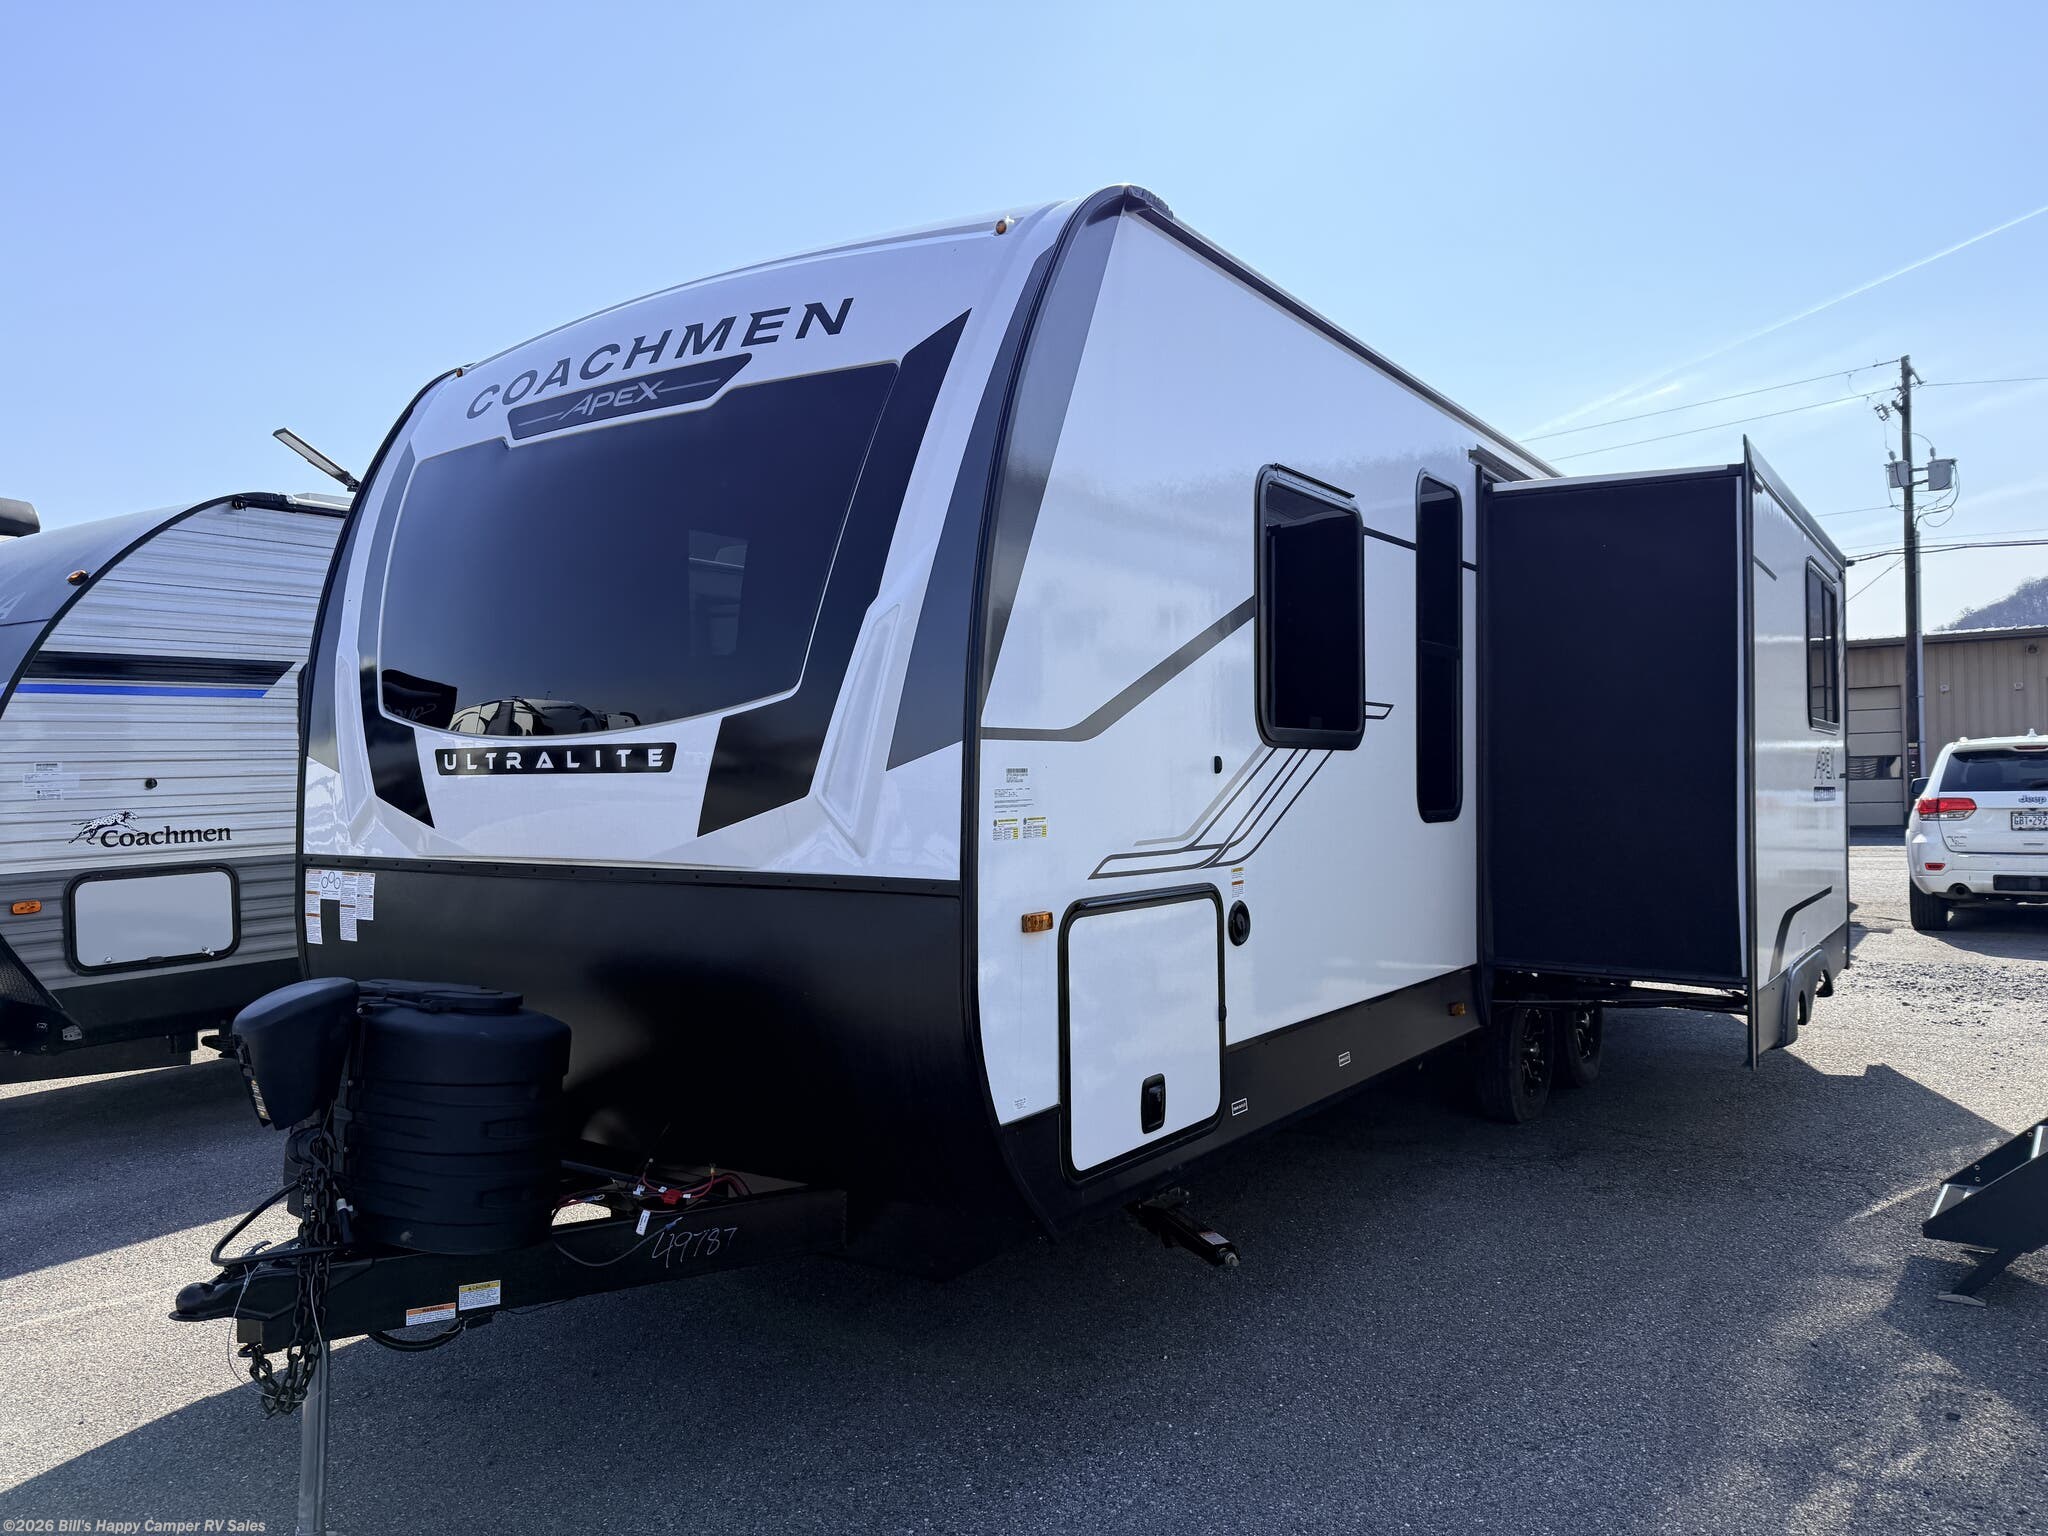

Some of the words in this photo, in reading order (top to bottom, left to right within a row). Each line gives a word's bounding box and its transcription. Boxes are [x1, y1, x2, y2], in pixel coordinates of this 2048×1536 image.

[466, 297, 855, 420] COACHMEN
[558, 380, 665, 421] APEX
[444, 748, 664, 770] ULTRALITE
[100, 826, 232, 848] Coachmen
[651, 1226, 738, 1269] 49787
